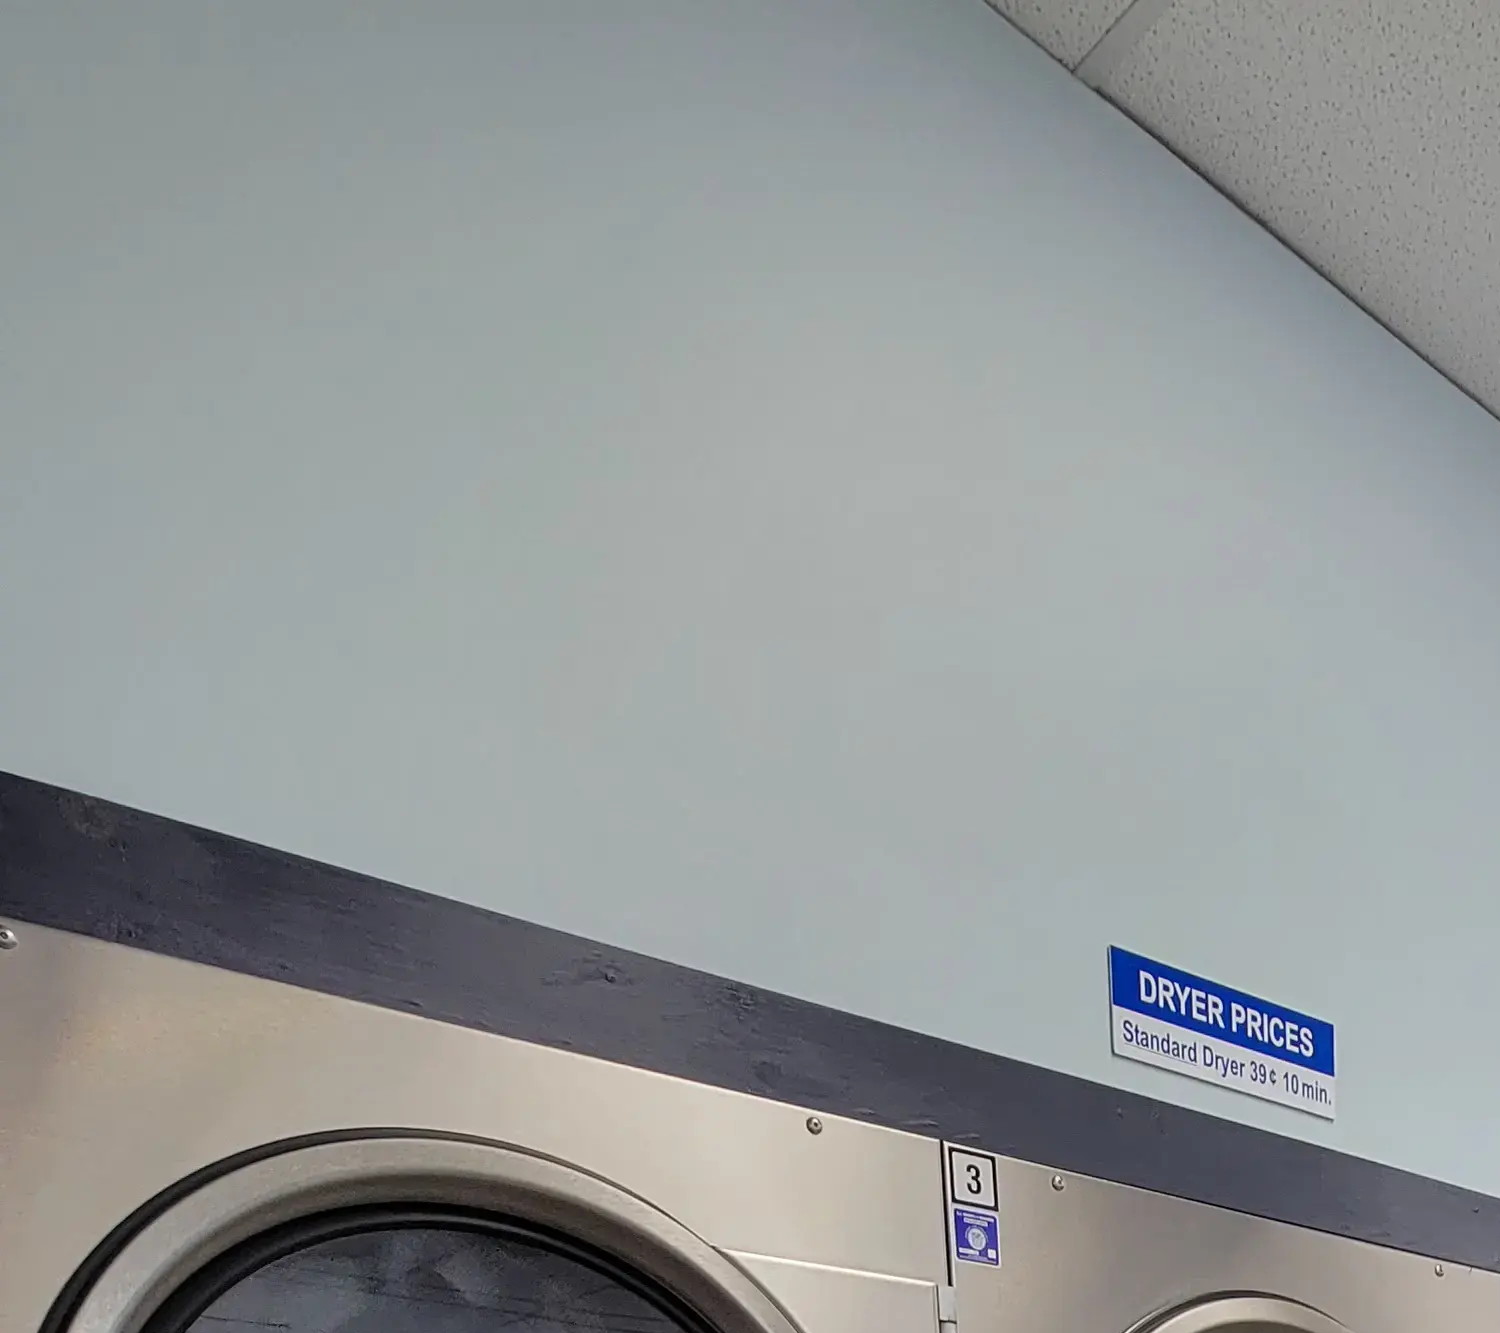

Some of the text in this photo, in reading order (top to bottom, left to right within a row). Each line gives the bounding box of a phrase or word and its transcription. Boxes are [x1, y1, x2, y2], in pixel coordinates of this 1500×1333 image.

[1139, 970, 1314, 1058] DRYER PRICES
[1122, 1020, 1198, 1064] Standard
[1203, 1046, 1245, 1078] Dryer
[1283, 1072, 1299, 1095] 10
[1301, 1079, 1332, 1106] min.
[966, 1164, 982, 1195] 3
